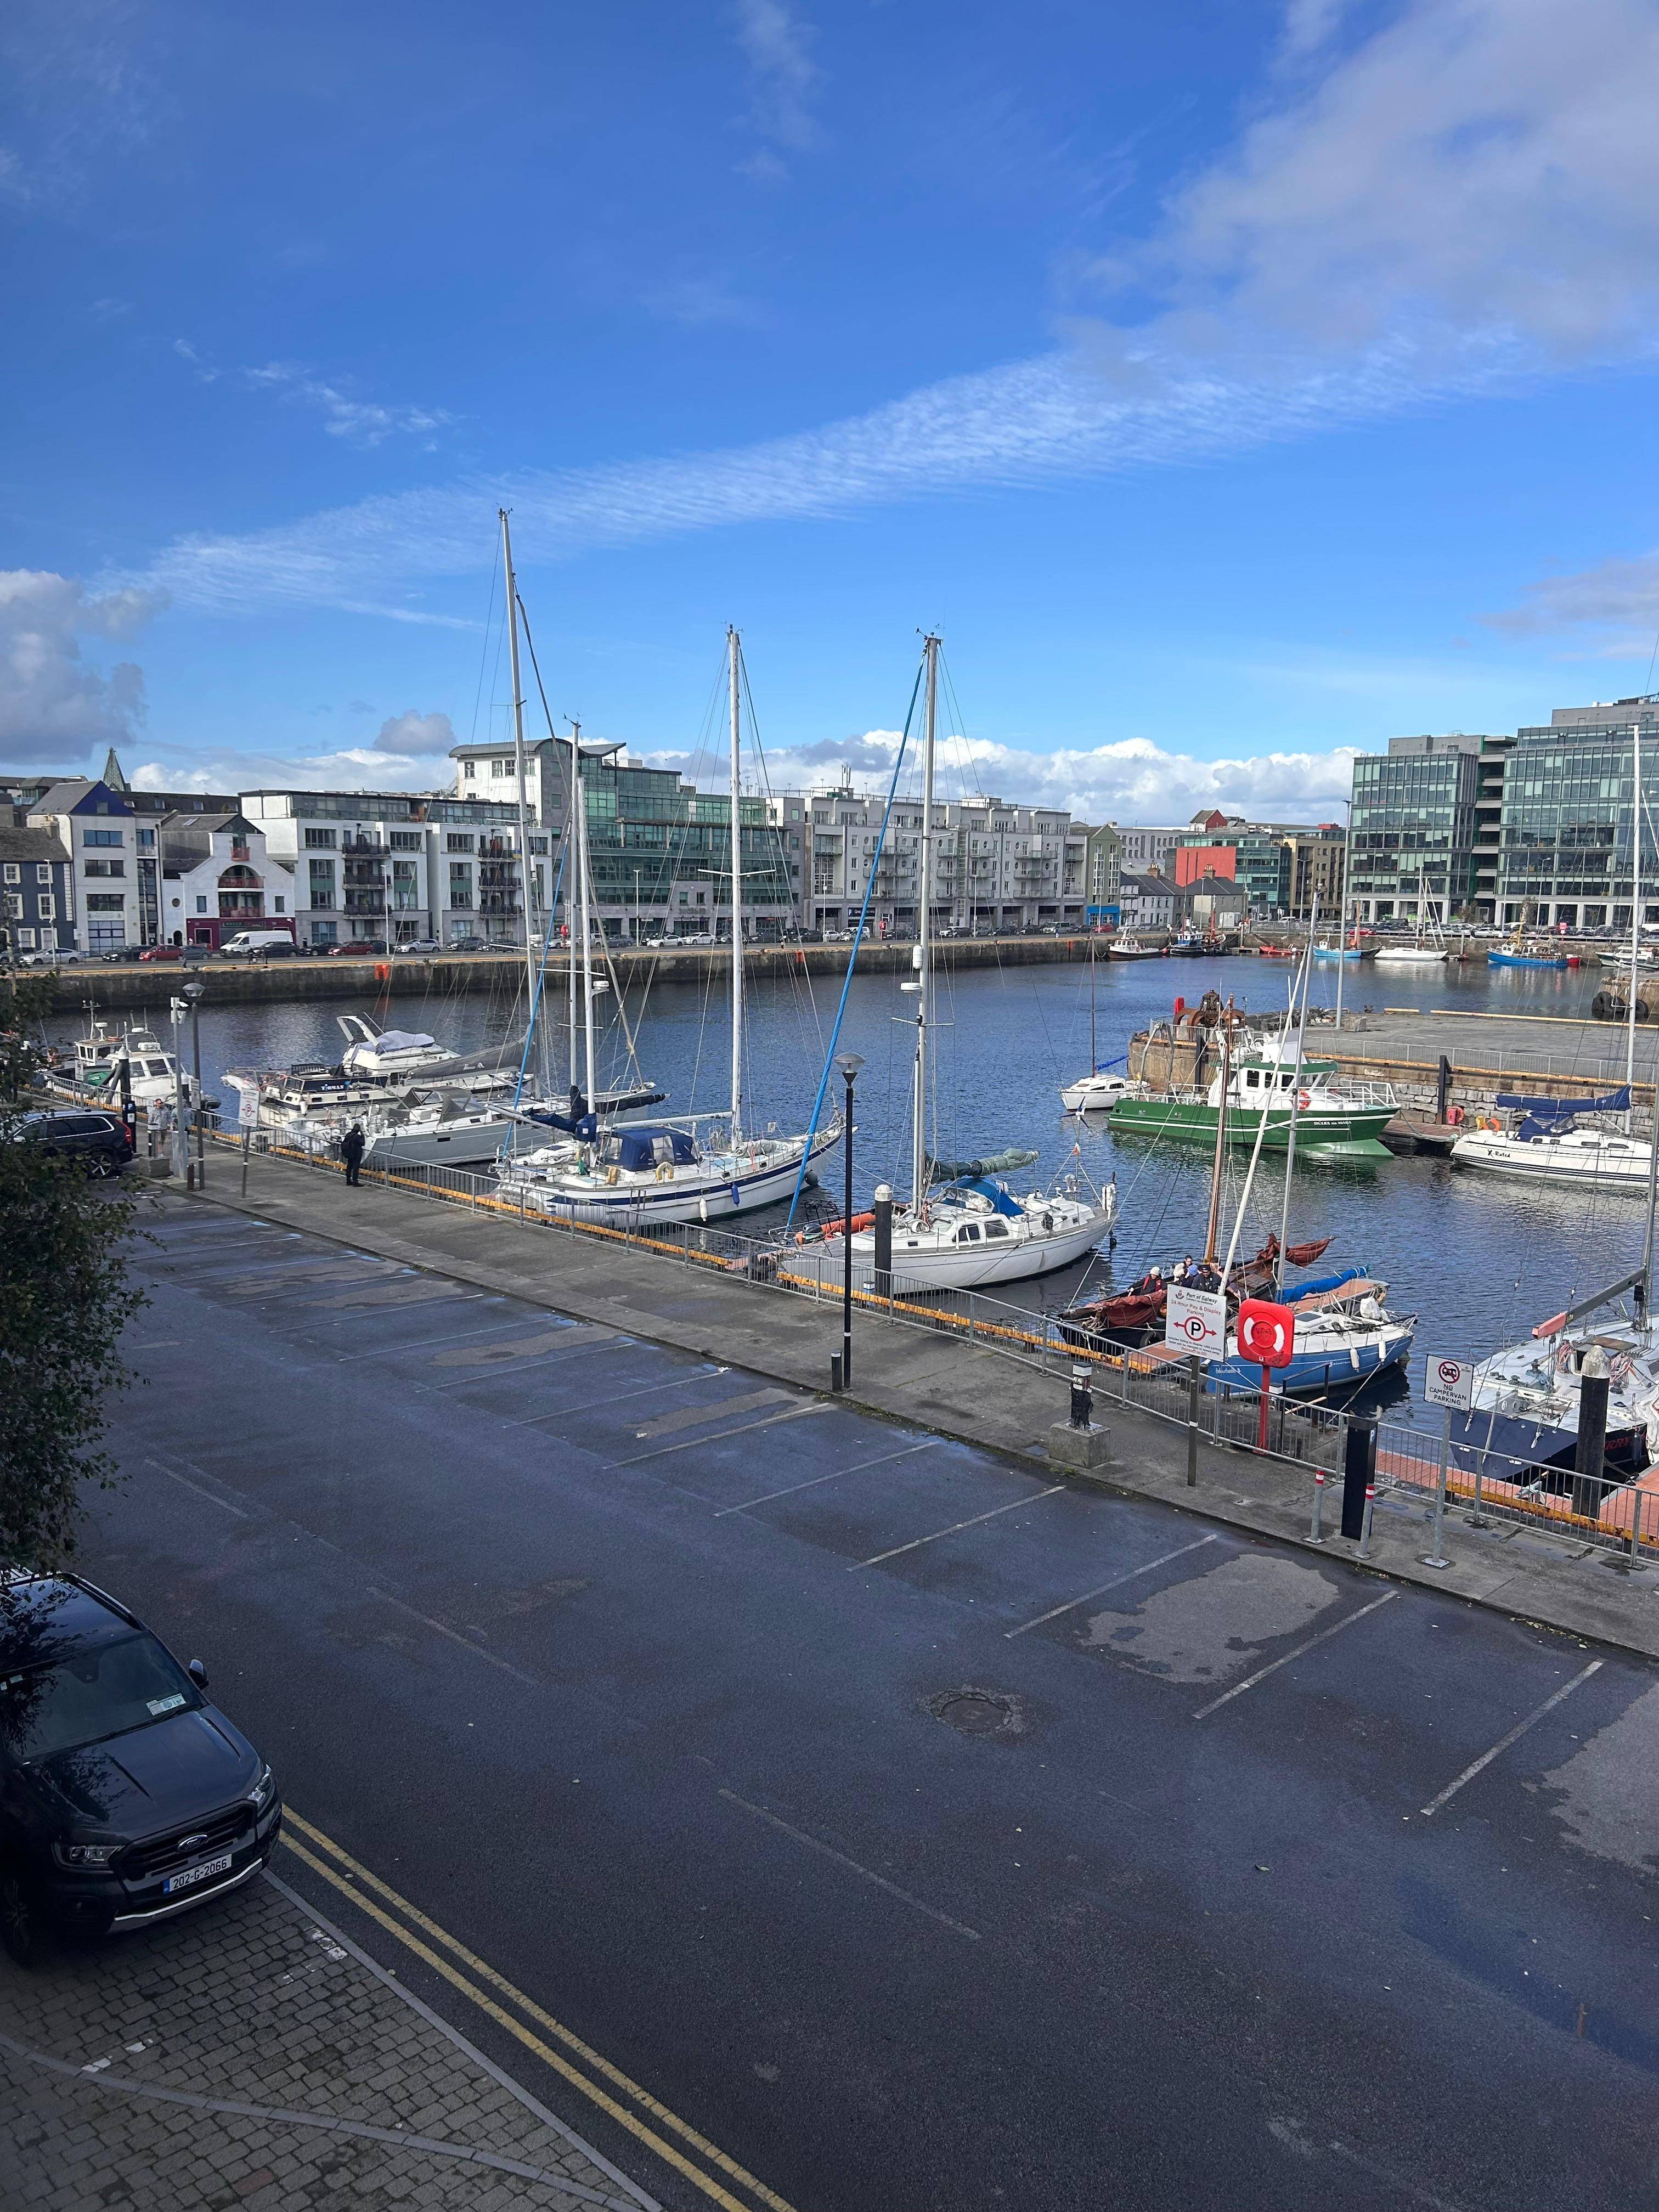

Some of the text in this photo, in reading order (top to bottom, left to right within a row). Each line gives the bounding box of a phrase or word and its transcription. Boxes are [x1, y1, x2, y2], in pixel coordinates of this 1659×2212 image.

[1487, 1149, 1511, 1158] X-Rated
[1201, 1296, 1218, 1304] Galway
[1187, 1308, 1204, 1317] Parking
[1204, 1307, 1221, 1316] Display
[1191, 1321, 1201, 1336] P
[1429, 1386, 1466, 1401] CAMPERVAN
[1434, 1394, 1461, 1406] PARKING
[1370, 1429, 1375, 1442] P
[173, 1858, 227, 1889] 202-G-2066
